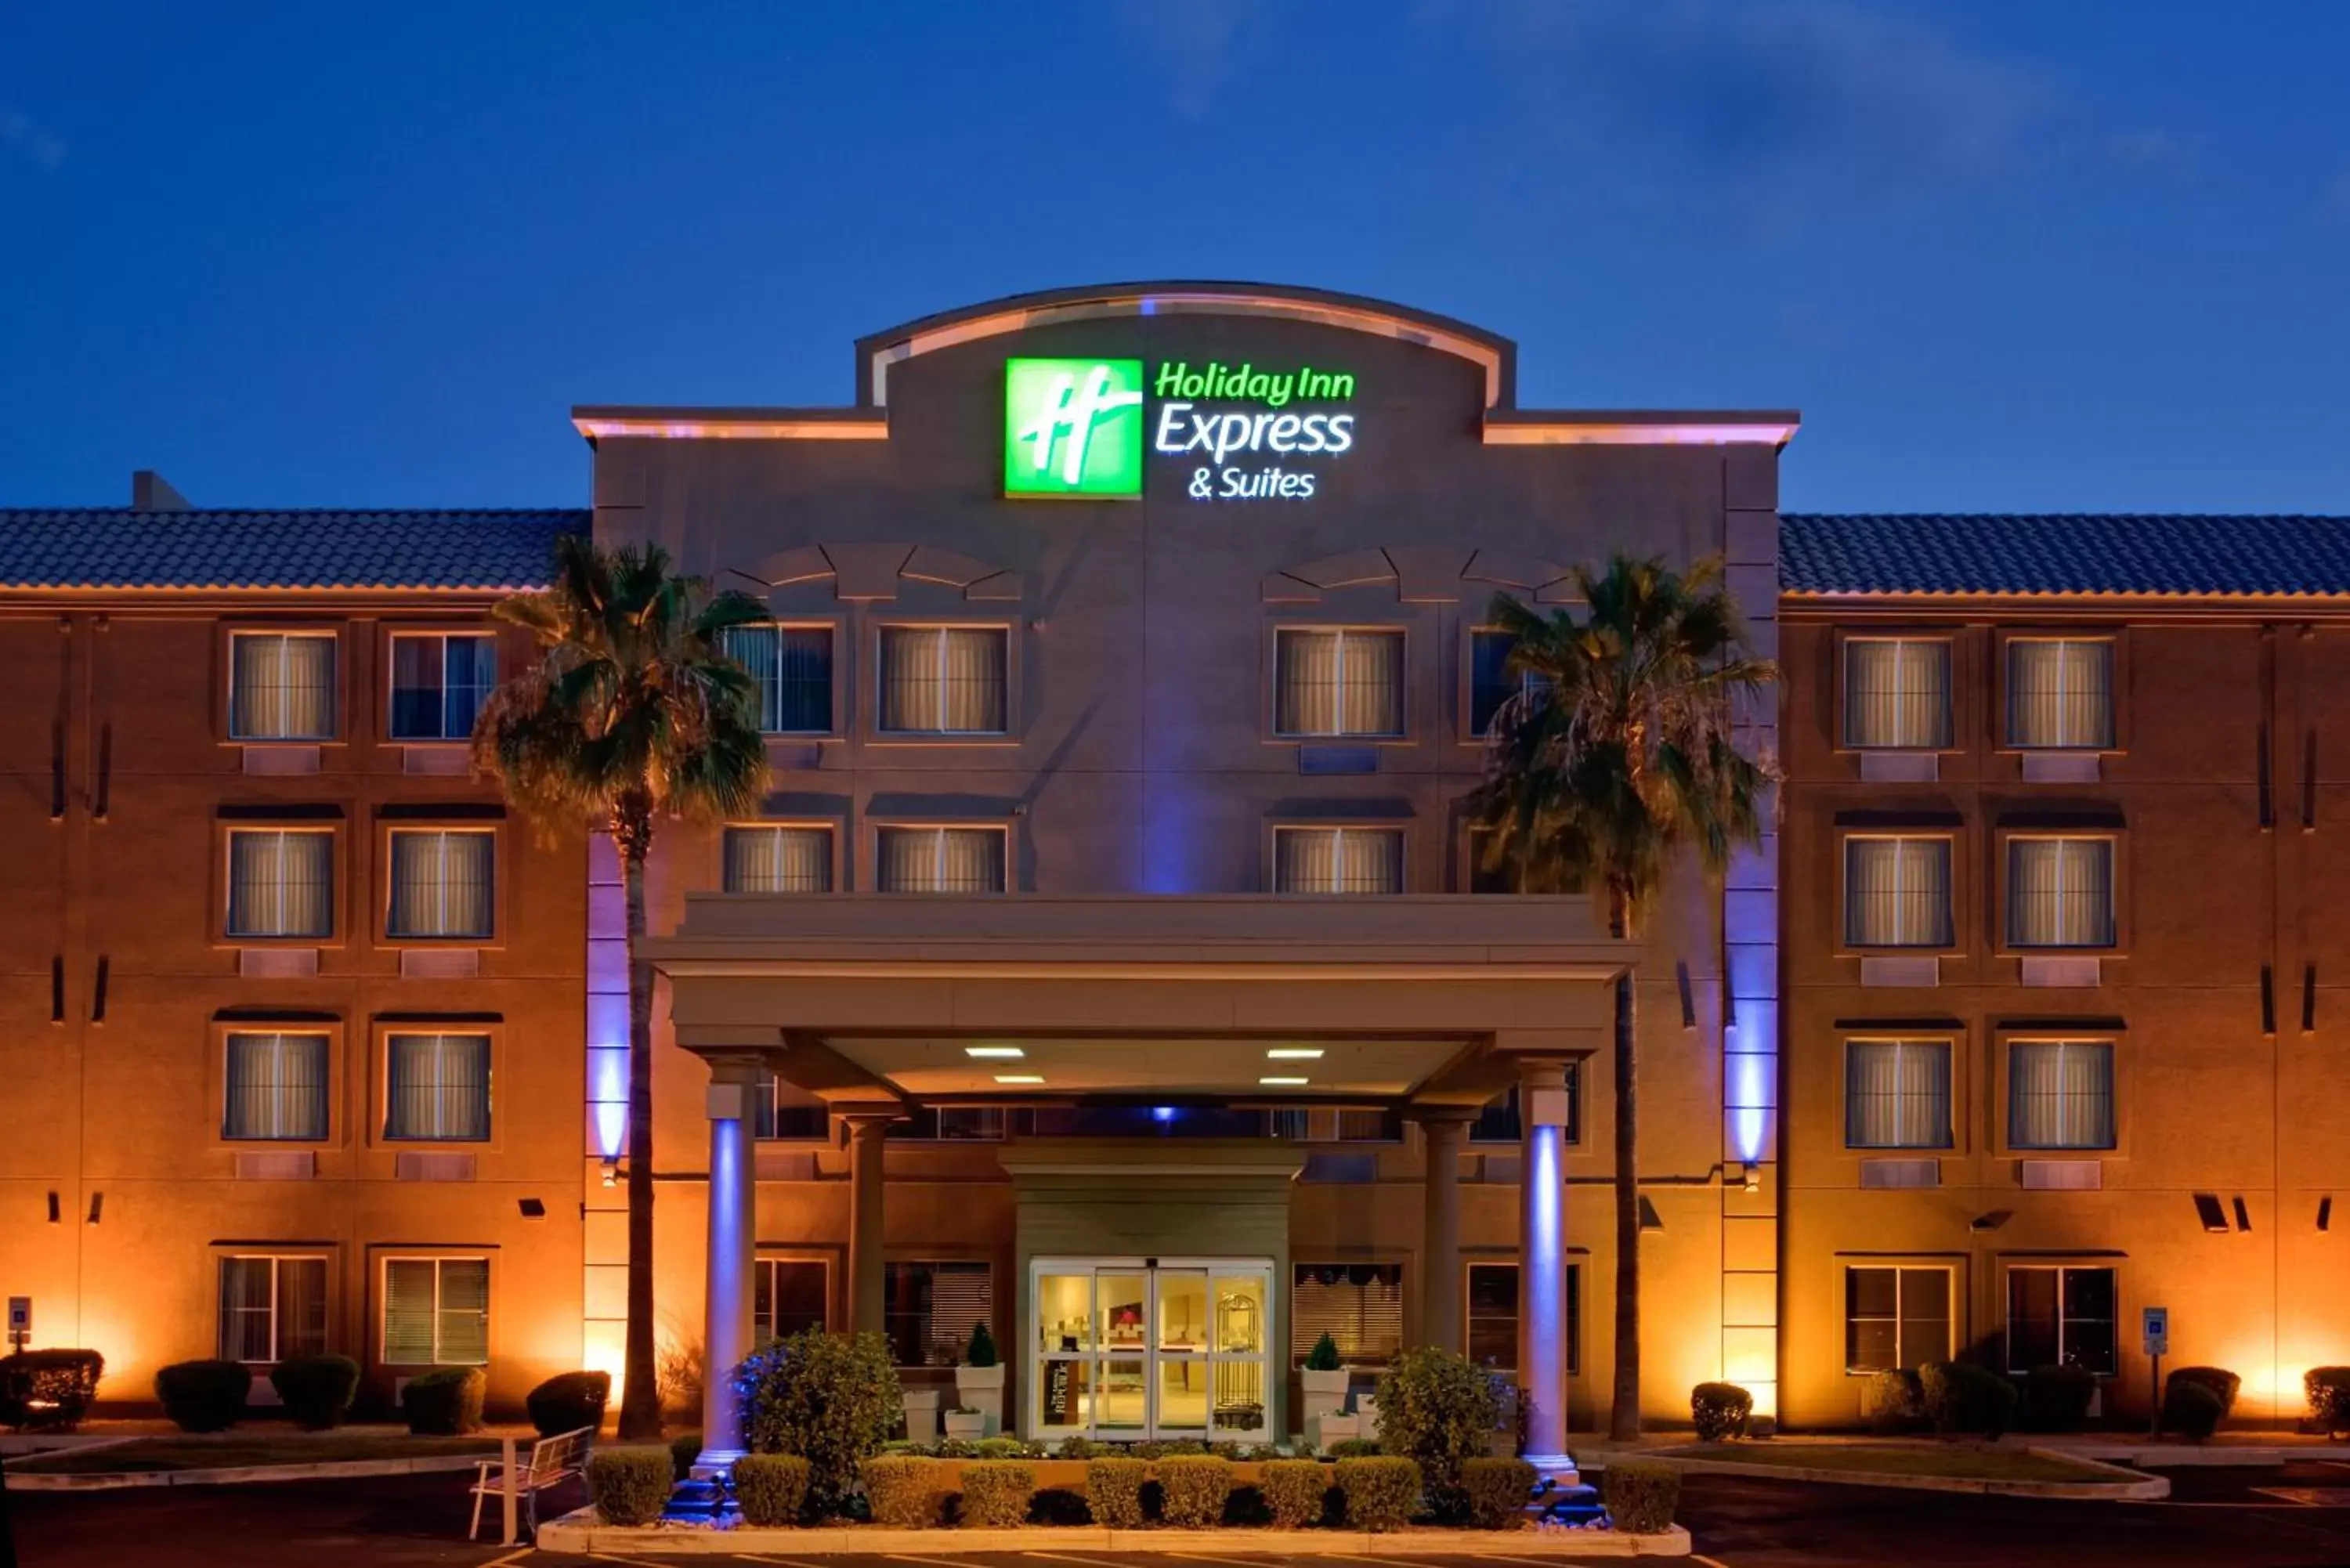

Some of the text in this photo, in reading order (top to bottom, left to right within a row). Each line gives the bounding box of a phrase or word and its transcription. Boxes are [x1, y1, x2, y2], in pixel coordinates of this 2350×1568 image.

[1155, 363, 1354, 406] Holiday Inn
[1155, 403, 1354, 464] Express
[1189, 468, 1315, 497] & Suites
